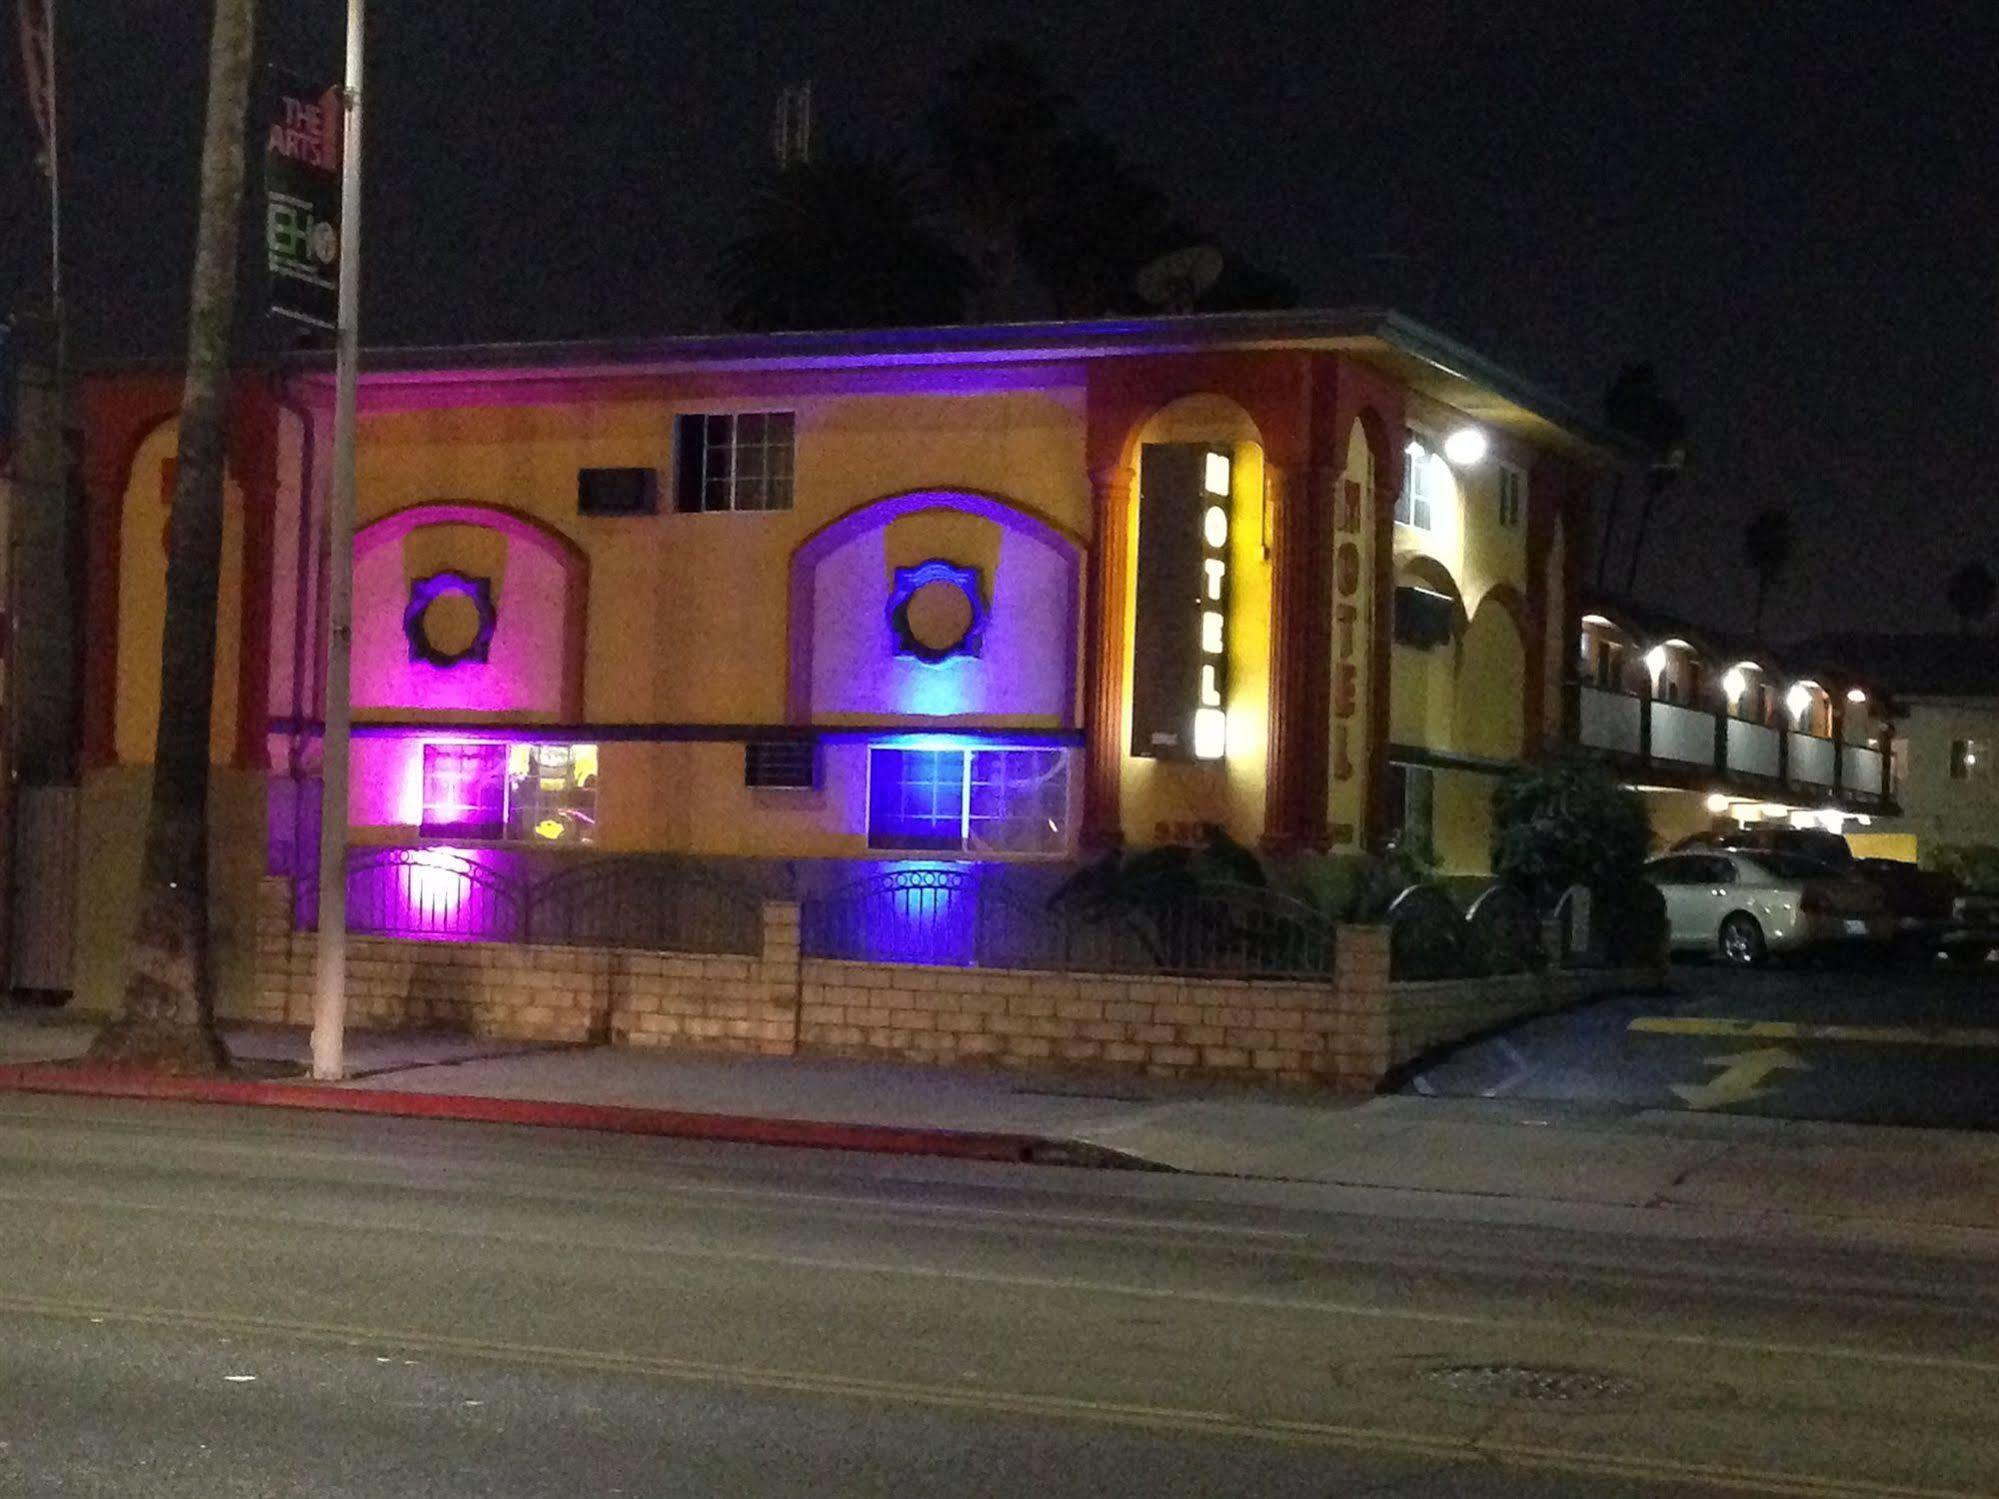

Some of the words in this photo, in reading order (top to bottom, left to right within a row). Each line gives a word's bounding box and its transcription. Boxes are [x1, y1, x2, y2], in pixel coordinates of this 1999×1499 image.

[268, 124, 321, 167] ARTS
[281, 96, 322, 130] THE
[1200, 451, 1230, 706] MOTEL
[1334, 478, 1361, 781] MOTEL
